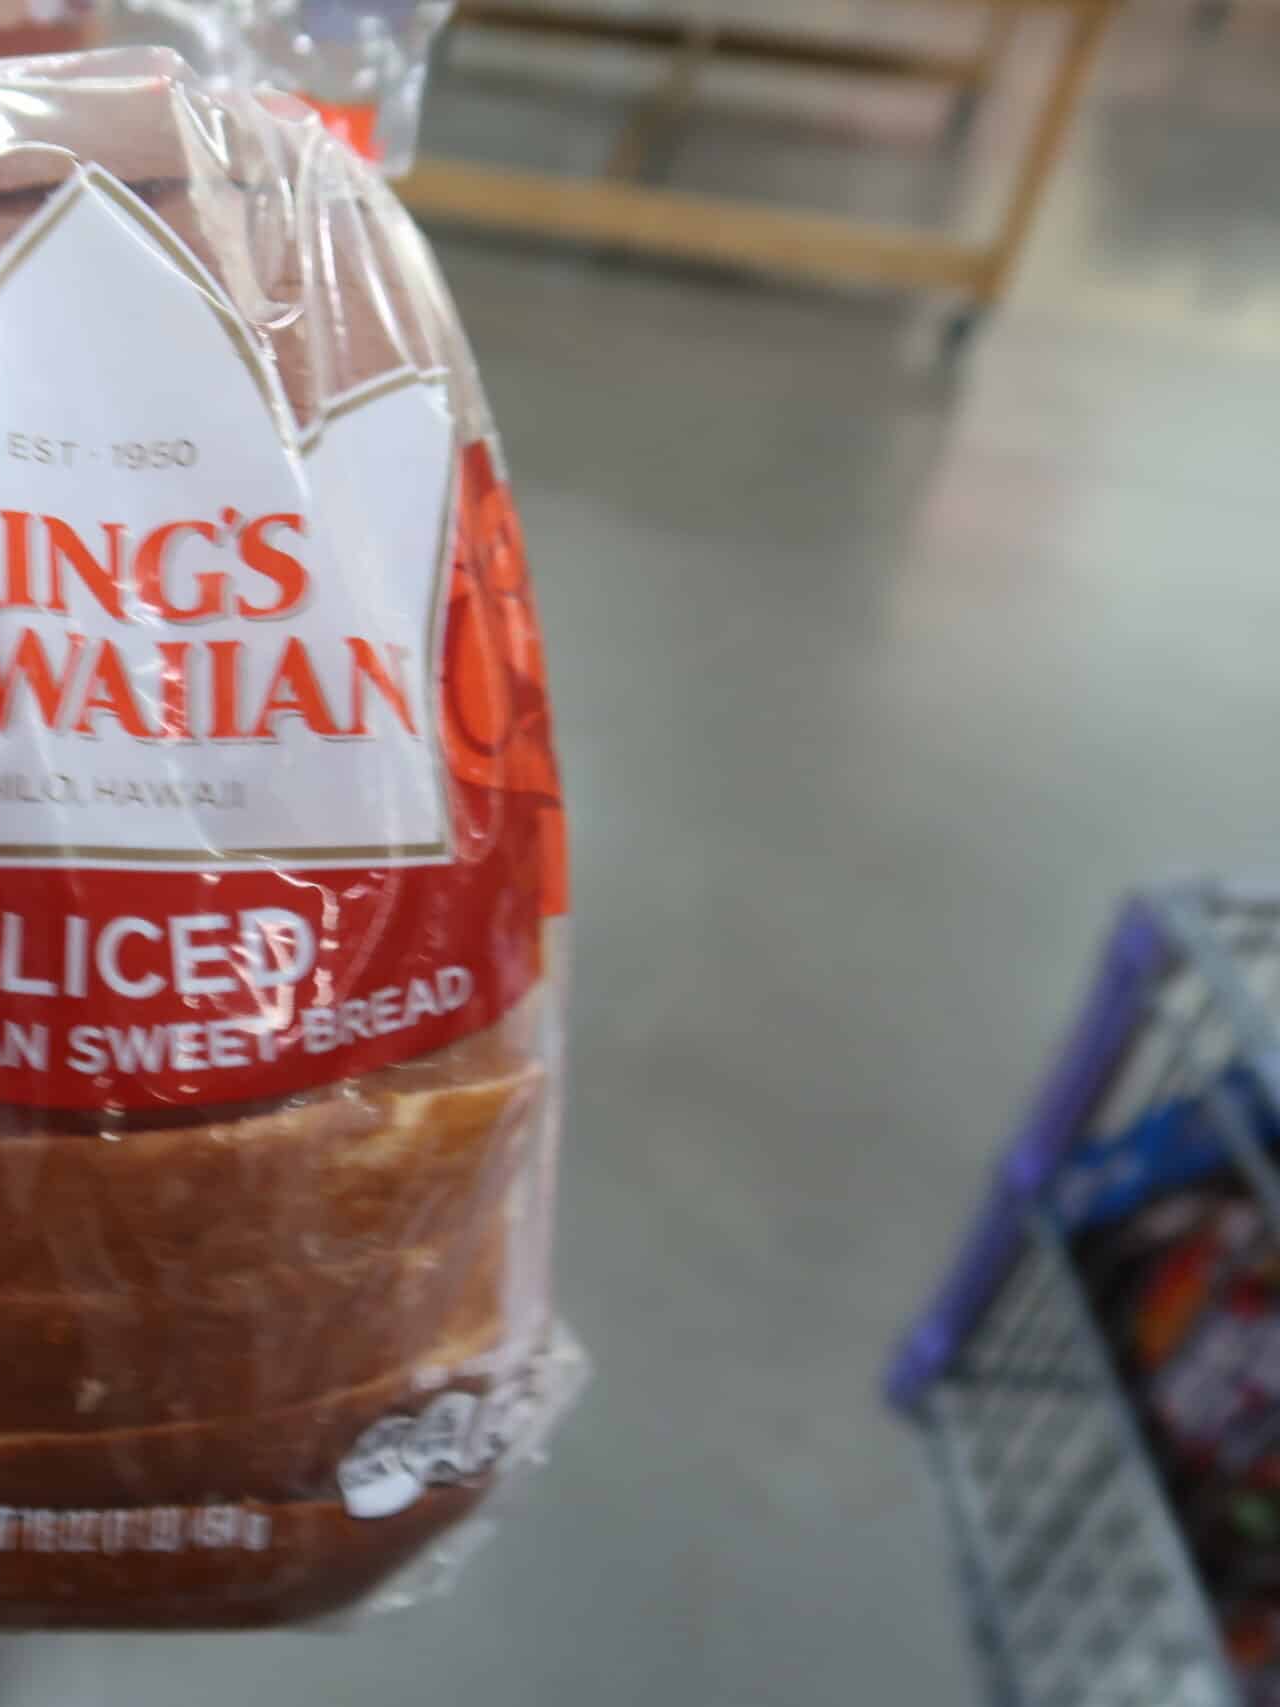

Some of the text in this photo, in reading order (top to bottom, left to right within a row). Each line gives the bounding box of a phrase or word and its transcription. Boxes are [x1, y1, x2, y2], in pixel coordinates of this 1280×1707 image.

[6, 430, 199, 471] EST 1950
[92, 774, 247, 810] HAWAII
[67, 1018, 282, 1075] SWEET
[300, 966, 475, 1054] BREAD
